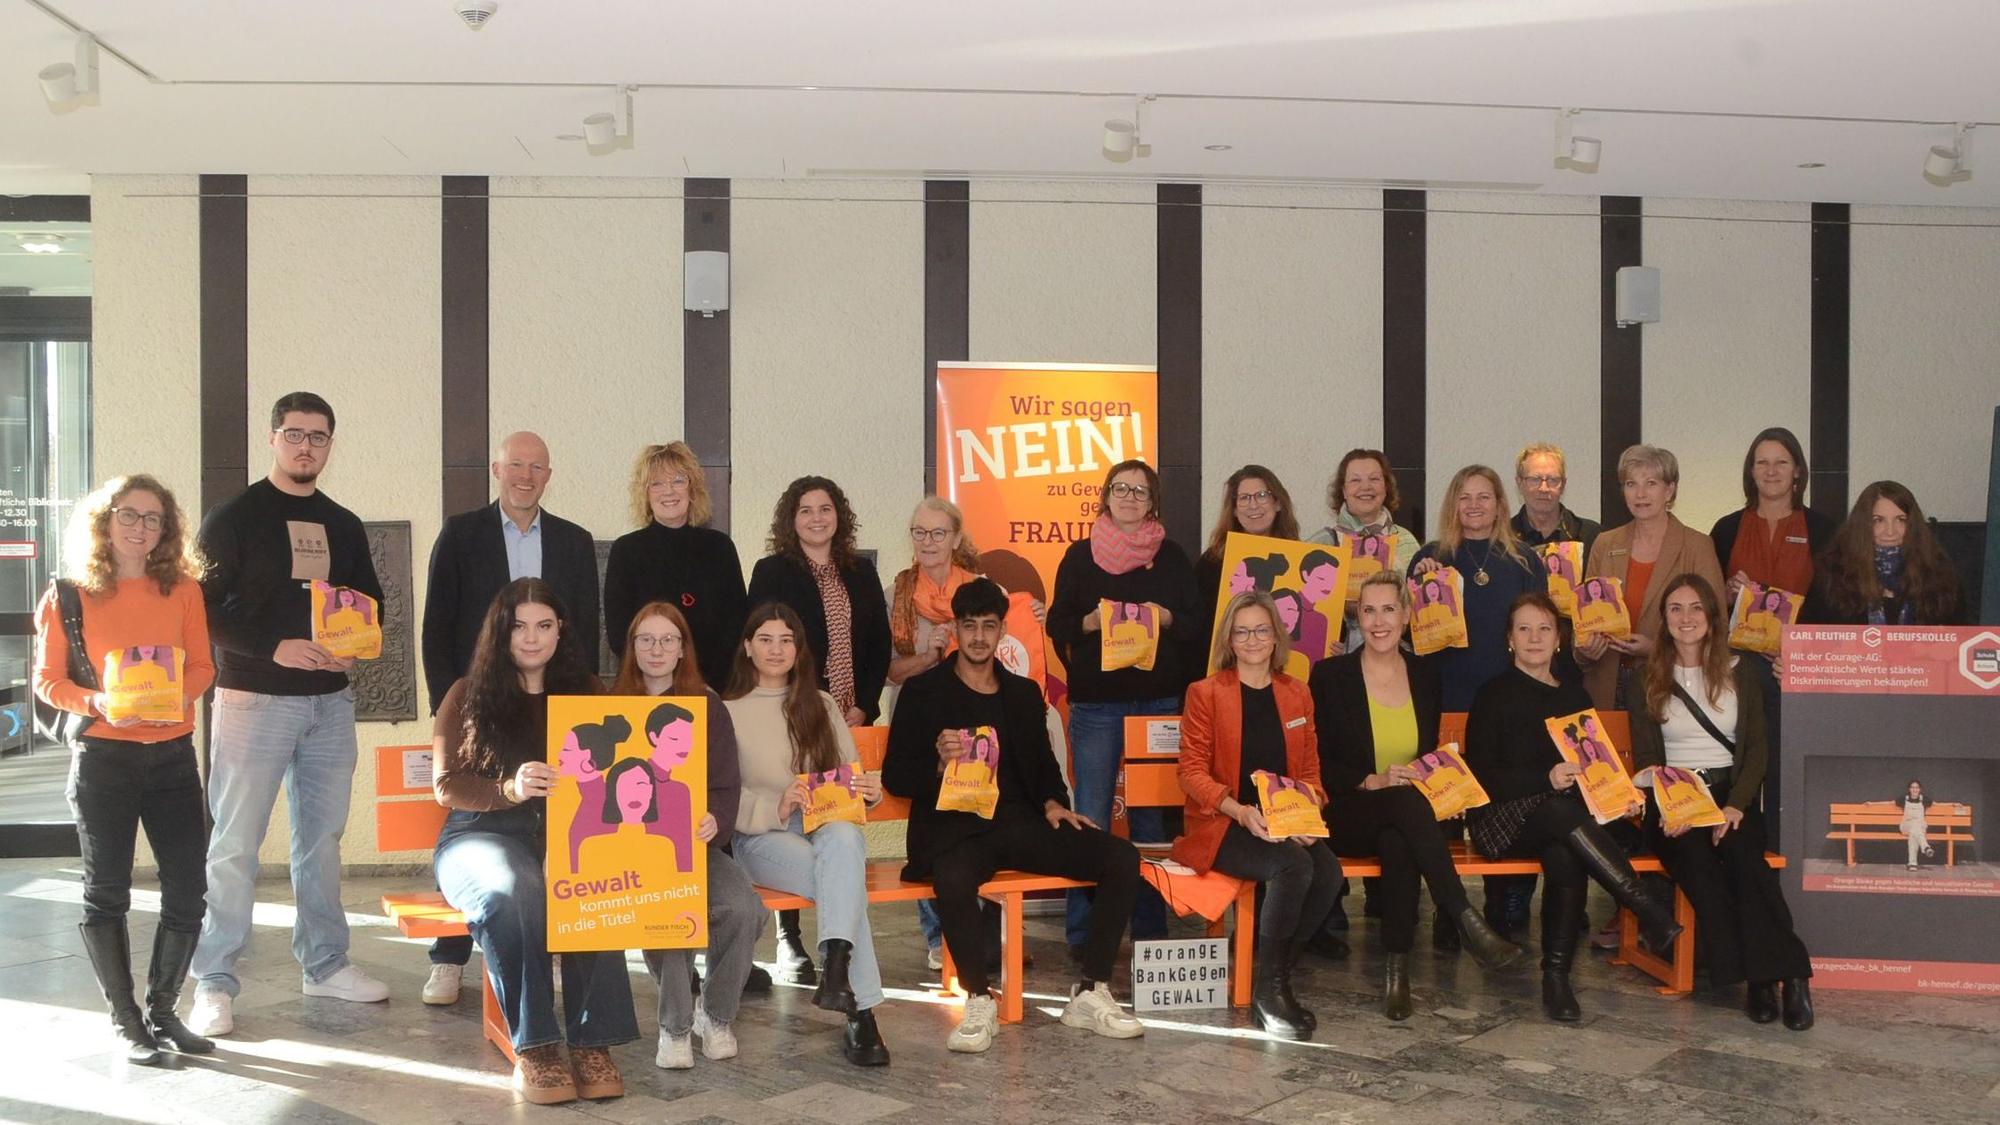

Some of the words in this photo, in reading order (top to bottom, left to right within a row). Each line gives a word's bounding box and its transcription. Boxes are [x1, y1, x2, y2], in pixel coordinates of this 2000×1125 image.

[1010, 395, 1054, 415] Wir
[1061, 400, 1132, 422] sagen
[955, 411, 1146, 483] NEIN!
[1047, 485, 1066, 496] zu
[1009, 521, 1095, 543] FRAU
[317, 626, 353, 639] Gewalt
[1790, 632, 1813, 641] CARL
[1815, 632, 1857, 641] REUTHER
[1886, 632, 1957, 642] BERUFSKOLLEG
[1104, 637, 1136, 647] Gewalt
[1790, 652, 1804, 661] Mit
[1807, 653, 1822, 661] der
[1825, 652, 1882, 663] Courage-AG:
[1790, 664, 1857, 673] Demokratische
[1860, 665, 1887, 674] Werte
[1889, 665, 1924, 675] stärken
[1790, 676, 1872, 688] Diskriminierungen
[945, 777, 981, 788] Gewalt
[1265, 802, 1300, 815] Gewalt
[553, 871, 643, 899] Gewalt
[580, 895, 632, 913] kommt
[635, 892, 660, 905] uns
[663, 884, 700, 900] nicht
[557, 921, 571, 934] in
[574, 918, 597, 931] die
[1152, 988, 1215, 1006] GEWALT
